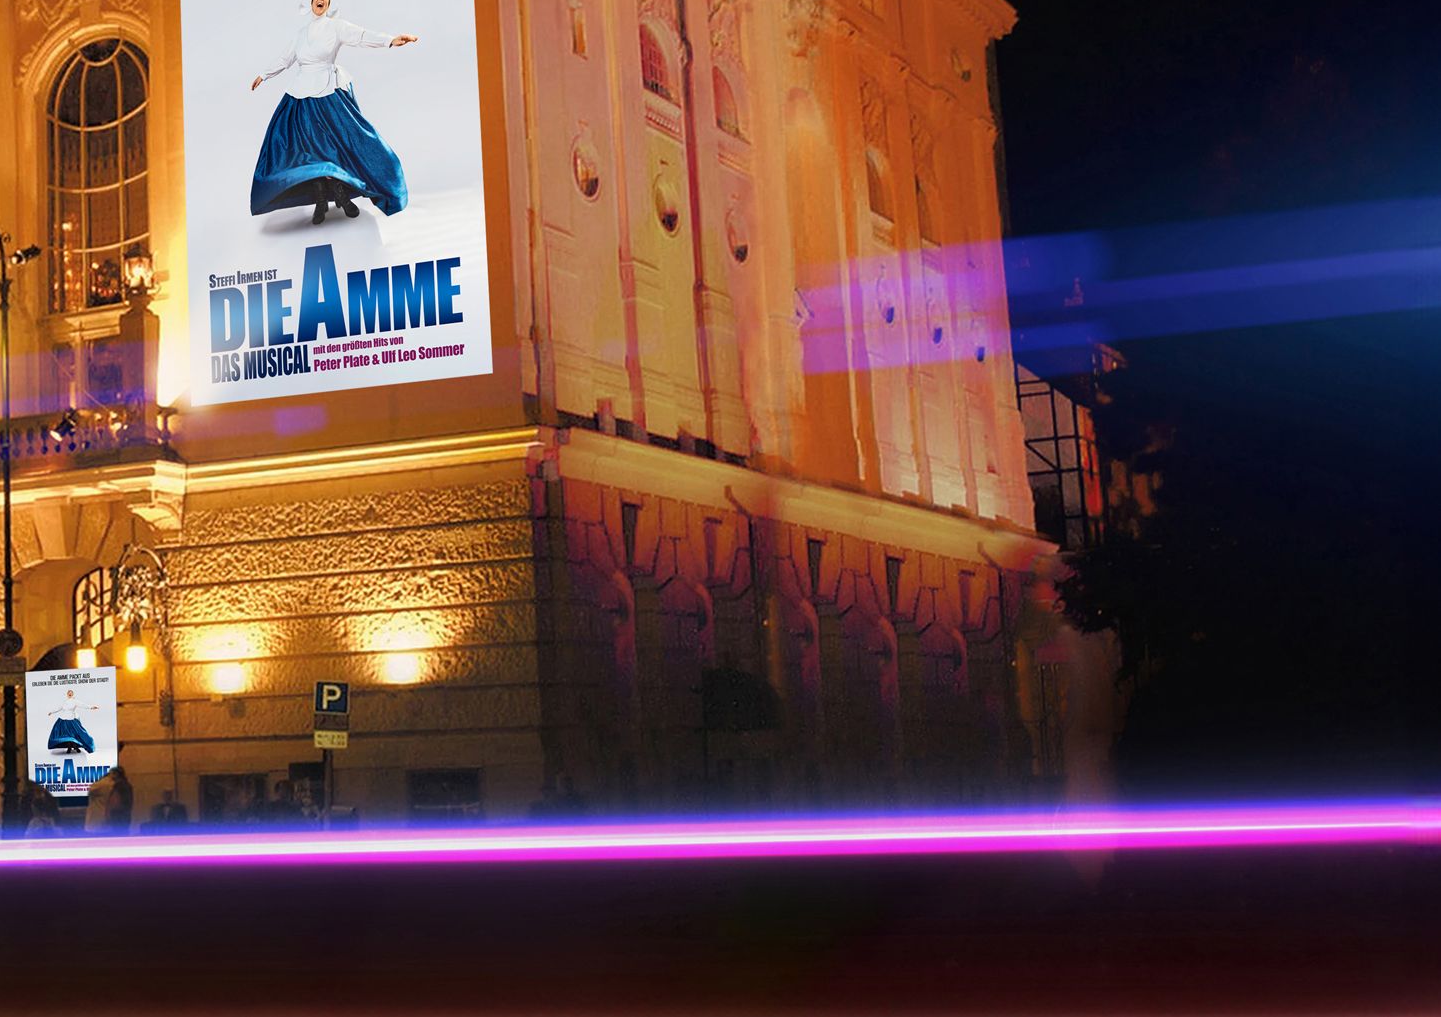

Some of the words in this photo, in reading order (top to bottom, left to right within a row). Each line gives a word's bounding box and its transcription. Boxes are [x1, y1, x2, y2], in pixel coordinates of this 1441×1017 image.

[209, 274, 235, 288] STEFFI
[237, 270, 263, 284] IRMEN
[265, 269, 277, 280] IST
[313, 344, 326, 355] mit
[327, 342, 341, 353] den
[373, 337, 388, 348] Hits
[389, 336, 403, 346] von
[314, 356, 341, 372] Peter
[343, 354, 370, 369] Plate
[372, 354, 379, 365] &
[382, 349, 396, 365] Ulf
[398, 348, 416, 363] Leo
[418, 343, 464, 361] Sommer
[211, 353, 240, 384] DAS
[244, 344, 311, 379] MUSICAL
[322, 685, 341, 709] P
